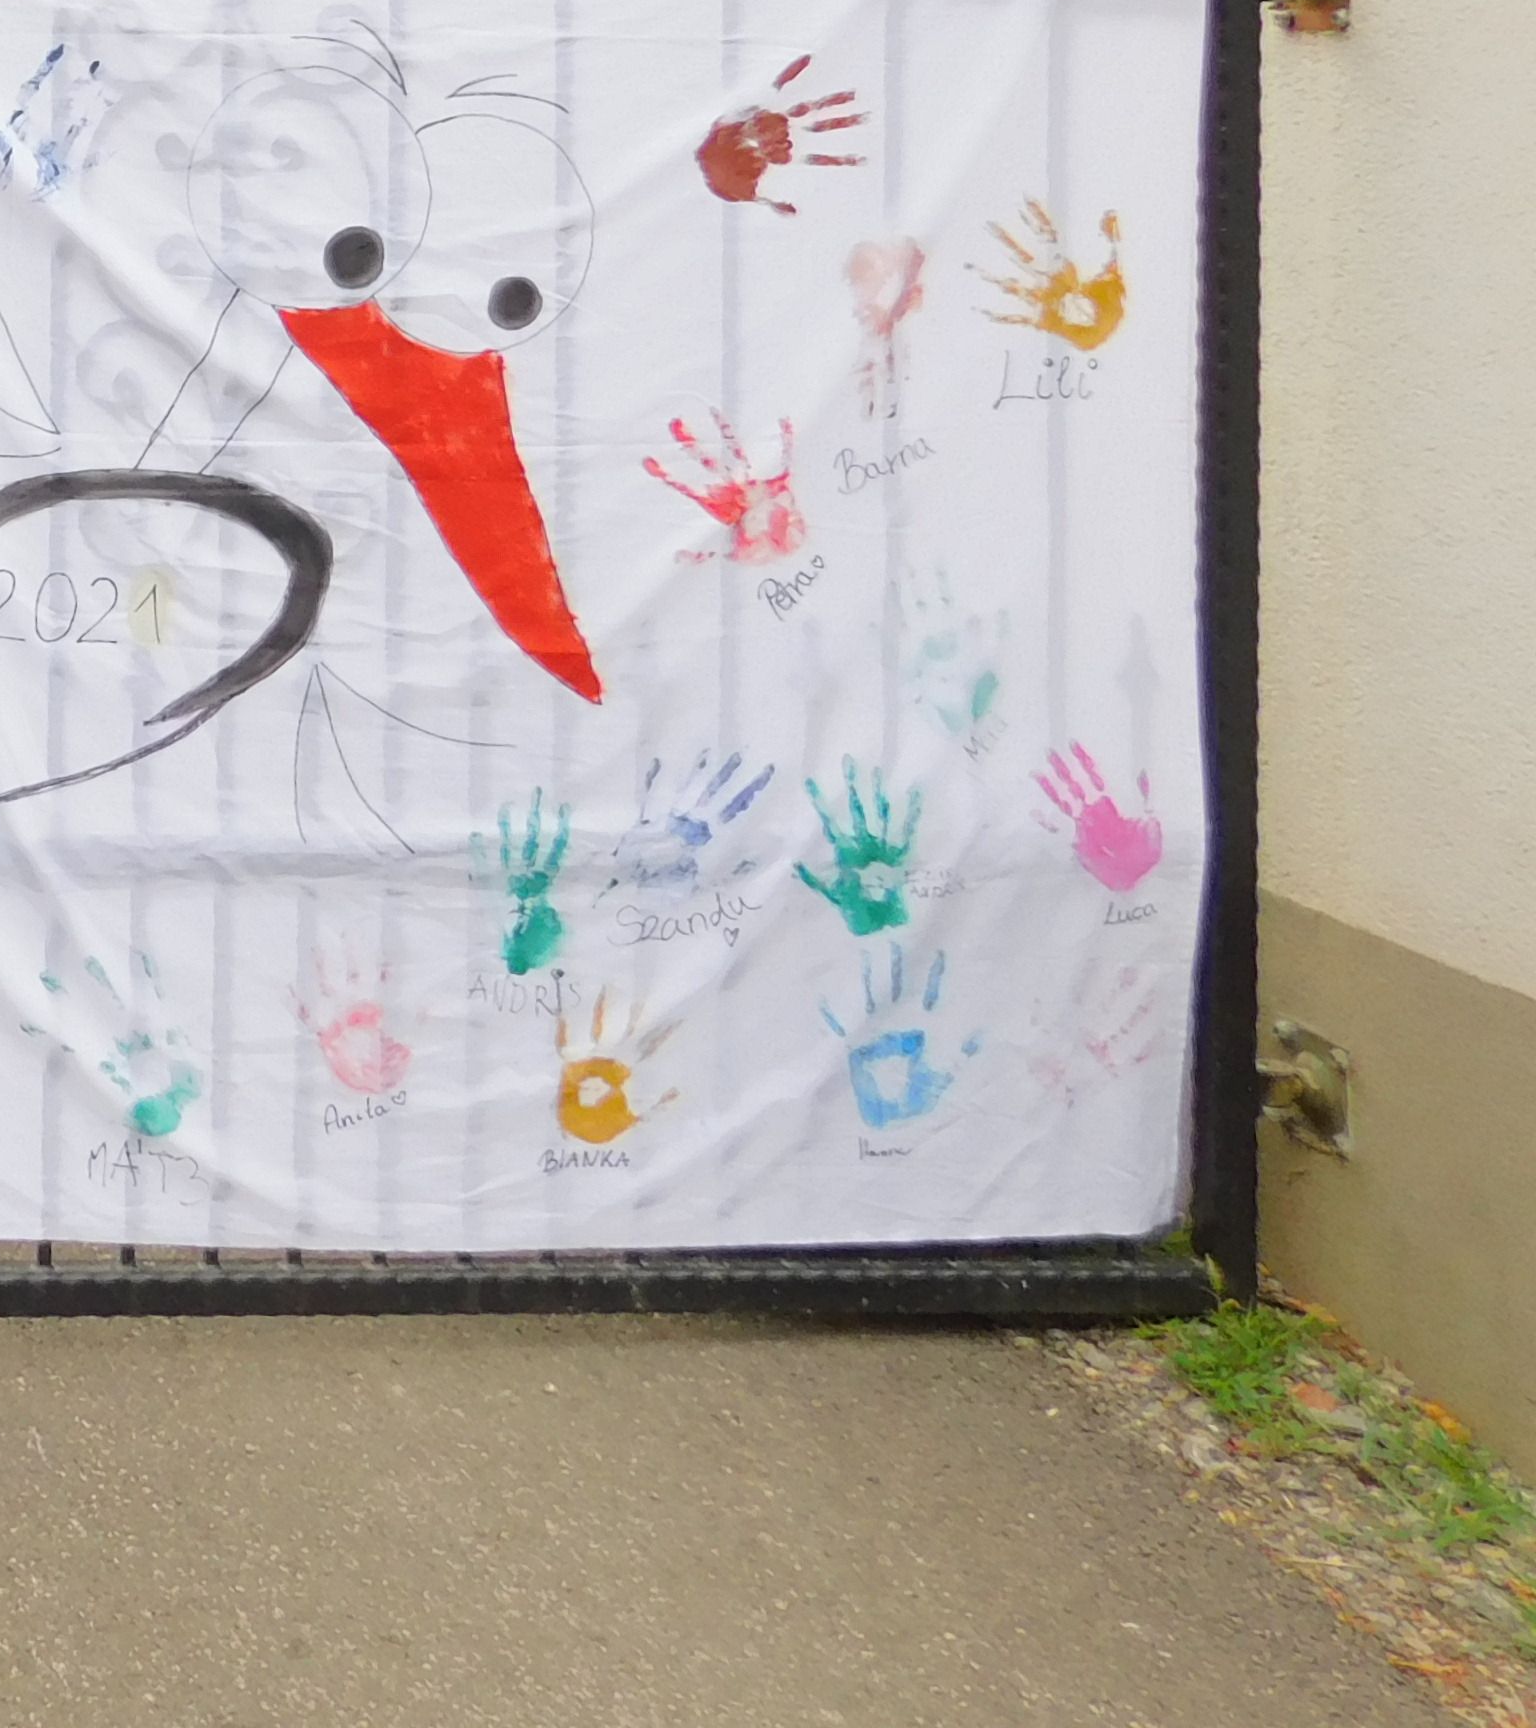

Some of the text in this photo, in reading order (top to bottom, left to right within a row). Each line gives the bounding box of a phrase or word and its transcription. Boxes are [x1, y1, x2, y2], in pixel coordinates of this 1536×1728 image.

[992, 350, 1098, 410] Lili
[832, 437, 937, 495] Barna
[1103, 901, 1159, 925] Luca
[536, 1148, 630, 1174] BIANKA
